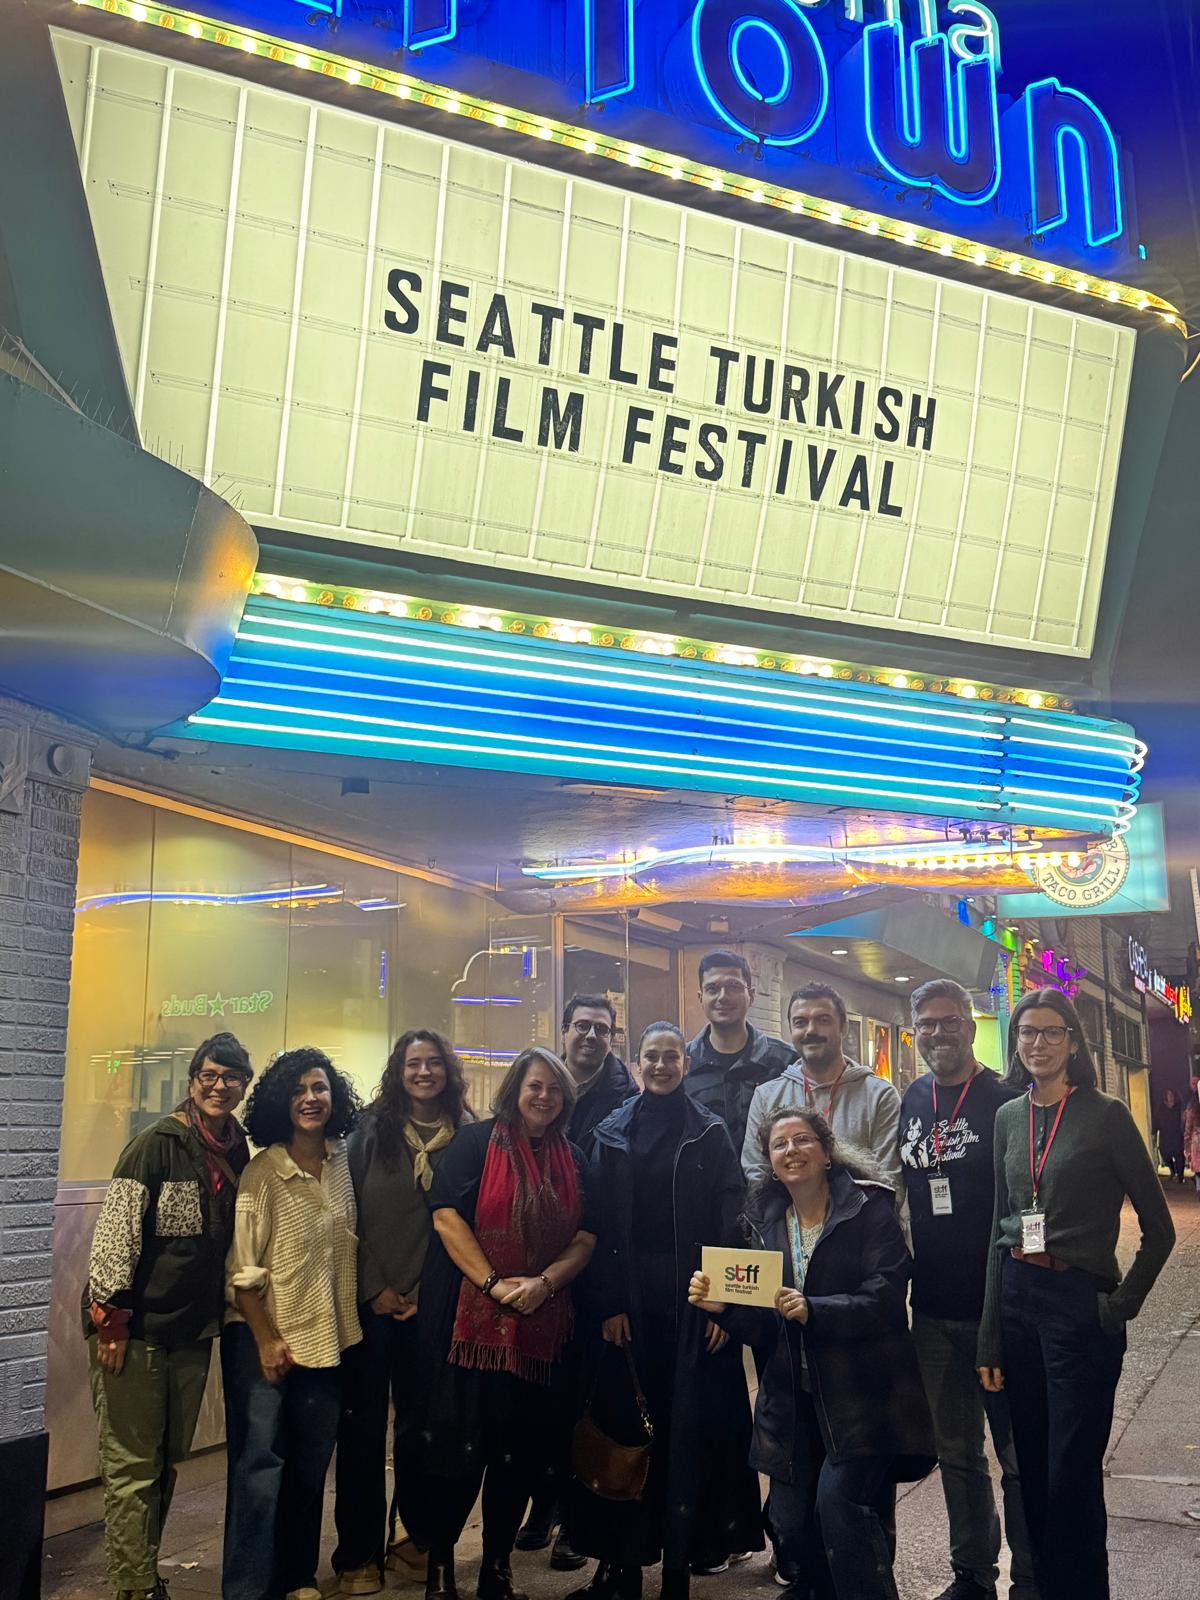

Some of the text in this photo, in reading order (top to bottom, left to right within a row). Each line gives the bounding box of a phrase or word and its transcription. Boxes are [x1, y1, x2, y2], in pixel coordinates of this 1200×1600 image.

[384, 268, 937, 451] SEATTLE TURKISH
[416, 359, 903, 517] FILM FESTIVAL
[1043, 868, 1120, 900] TACO GRILL
[725, 1264, 760, 1283] stff
